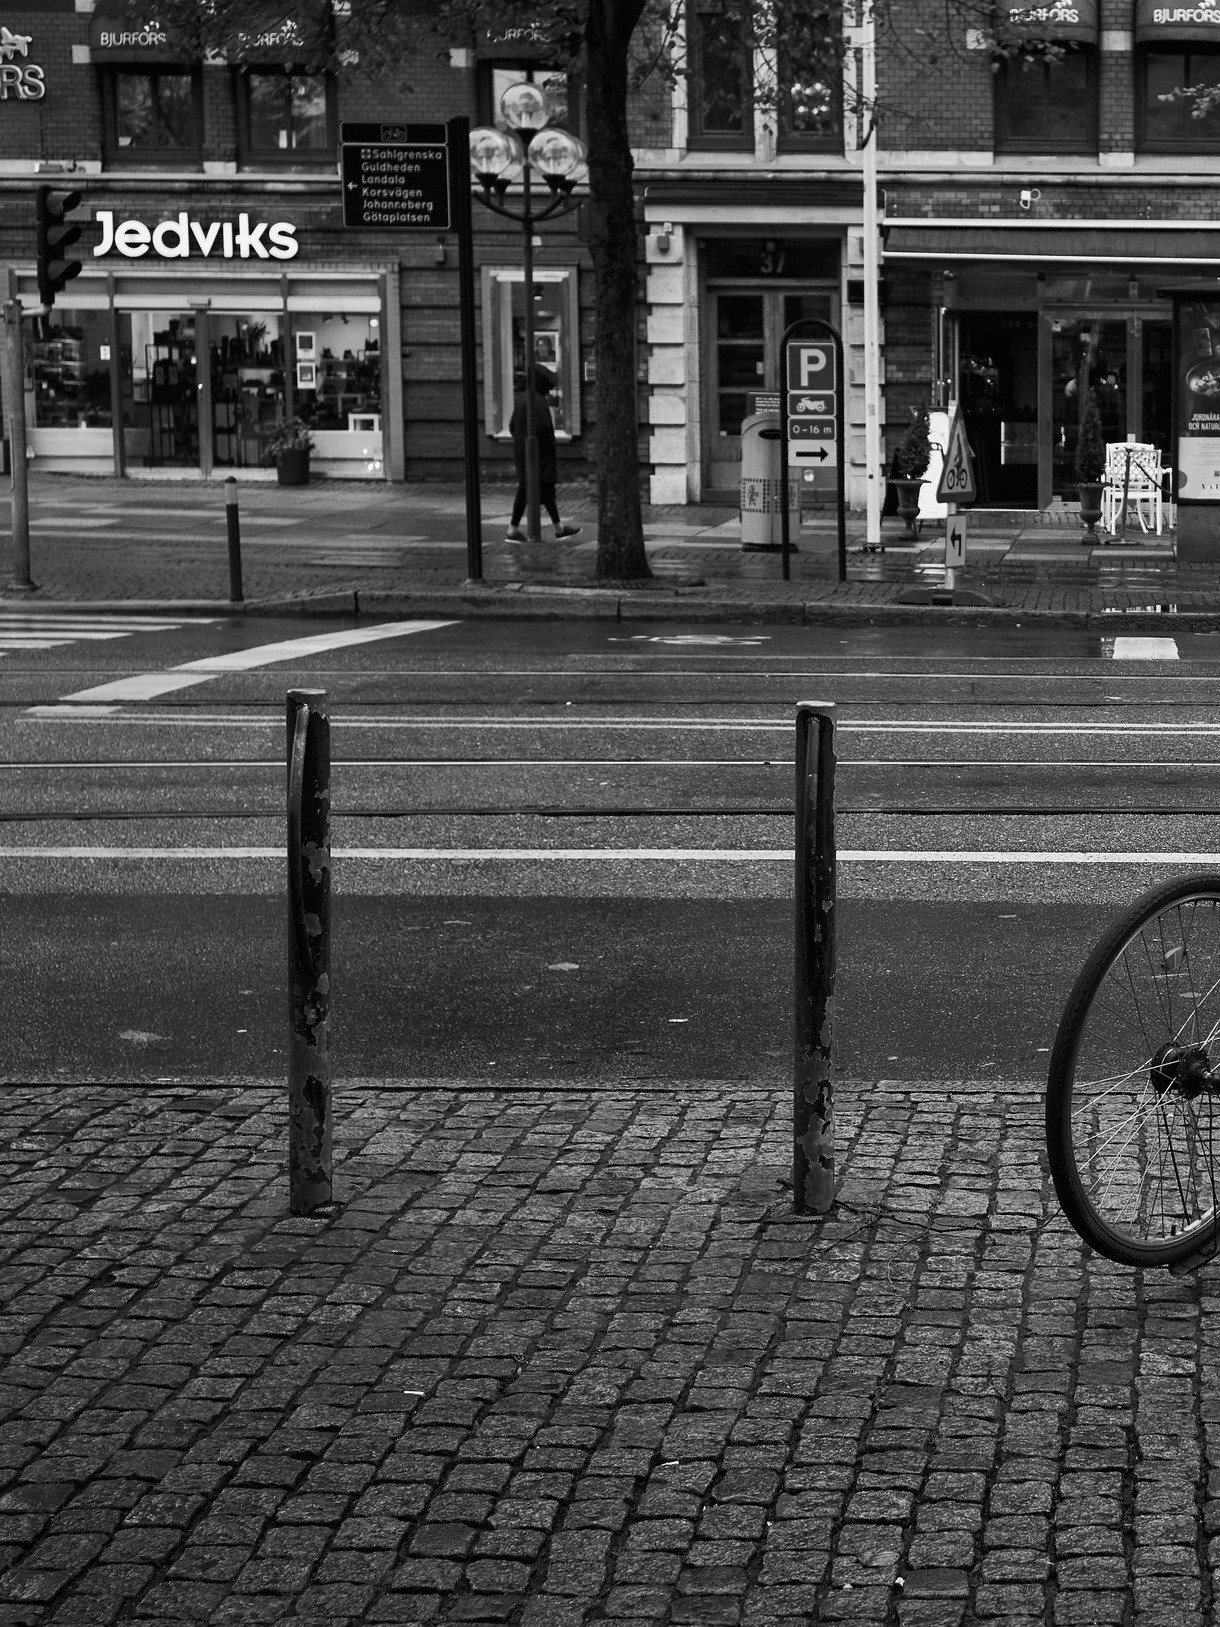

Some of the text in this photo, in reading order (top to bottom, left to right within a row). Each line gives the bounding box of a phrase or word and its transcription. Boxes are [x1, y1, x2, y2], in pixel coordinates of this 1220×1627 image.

[100, 31, 167, 48] BJURFORS
[372, 148, 443, 161] Sahlgrenska
[361, 162, 421, 172] Guldheden
[361, 174, 406, 184] Landala
[362, 186, 423, 199] Korsvägen
[362, 199, 433, 212] Johanneberg
[362, 211, 431, 223] Götaplatsen
[93, 210, 299, 260] Jedviks
[760, 252, 786, 274] 37
[800, 348, 827, 386] P
[823, 426, 832, 434] m
[1188, 422, 1200, 430] OCH
